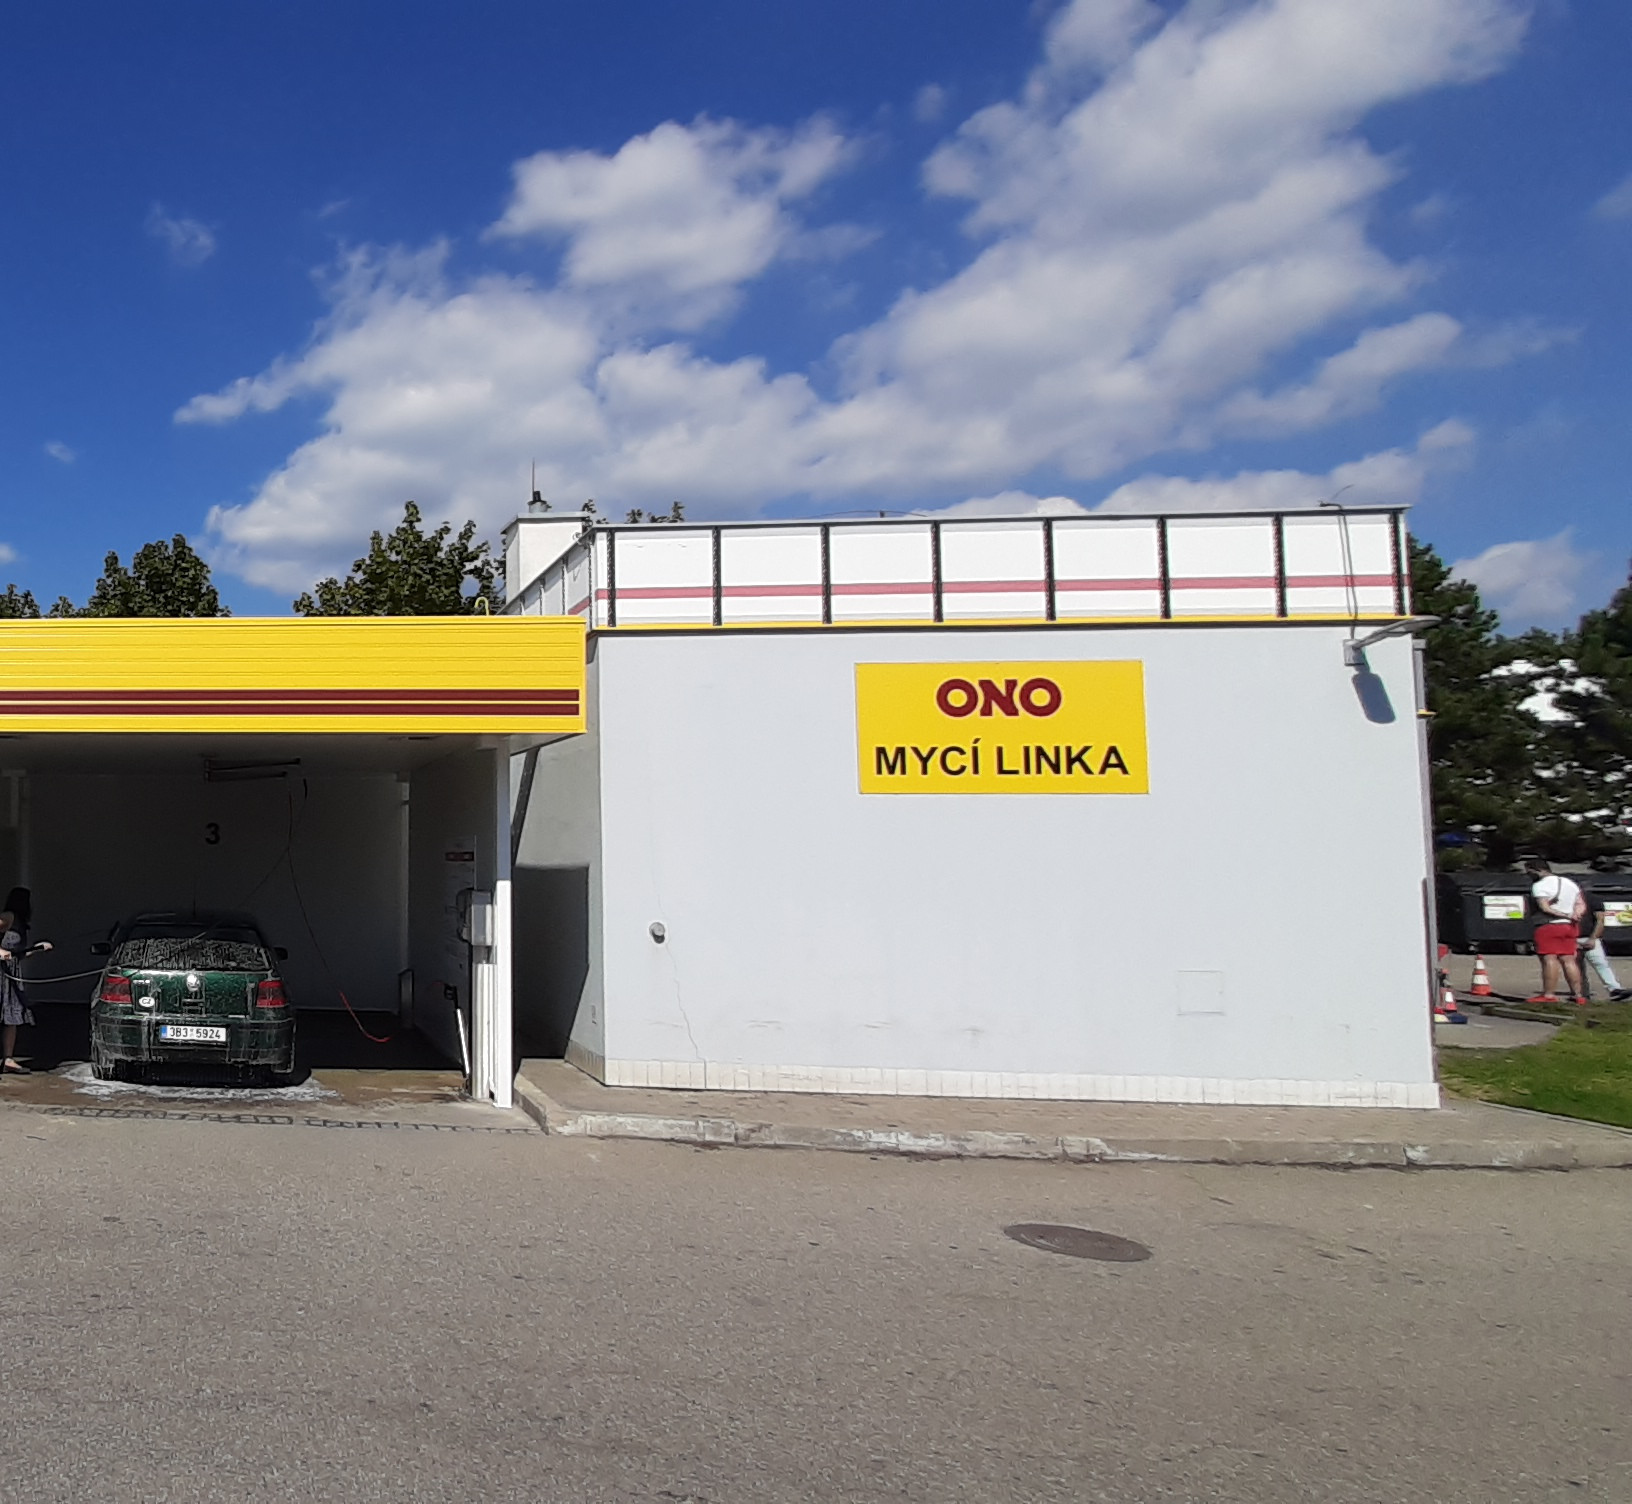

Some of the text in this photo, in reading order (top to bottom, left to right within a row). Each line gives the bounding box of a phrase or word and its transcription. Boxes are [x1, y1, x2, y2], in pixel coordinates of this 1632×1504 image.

[936, 678, 1062, 718] ONO
[875, 737, 1130, 776] MYCÍ LINKA
[206, 822, 220, 845] 3
[170, 1026, 221, 1040] 3B3 5924
